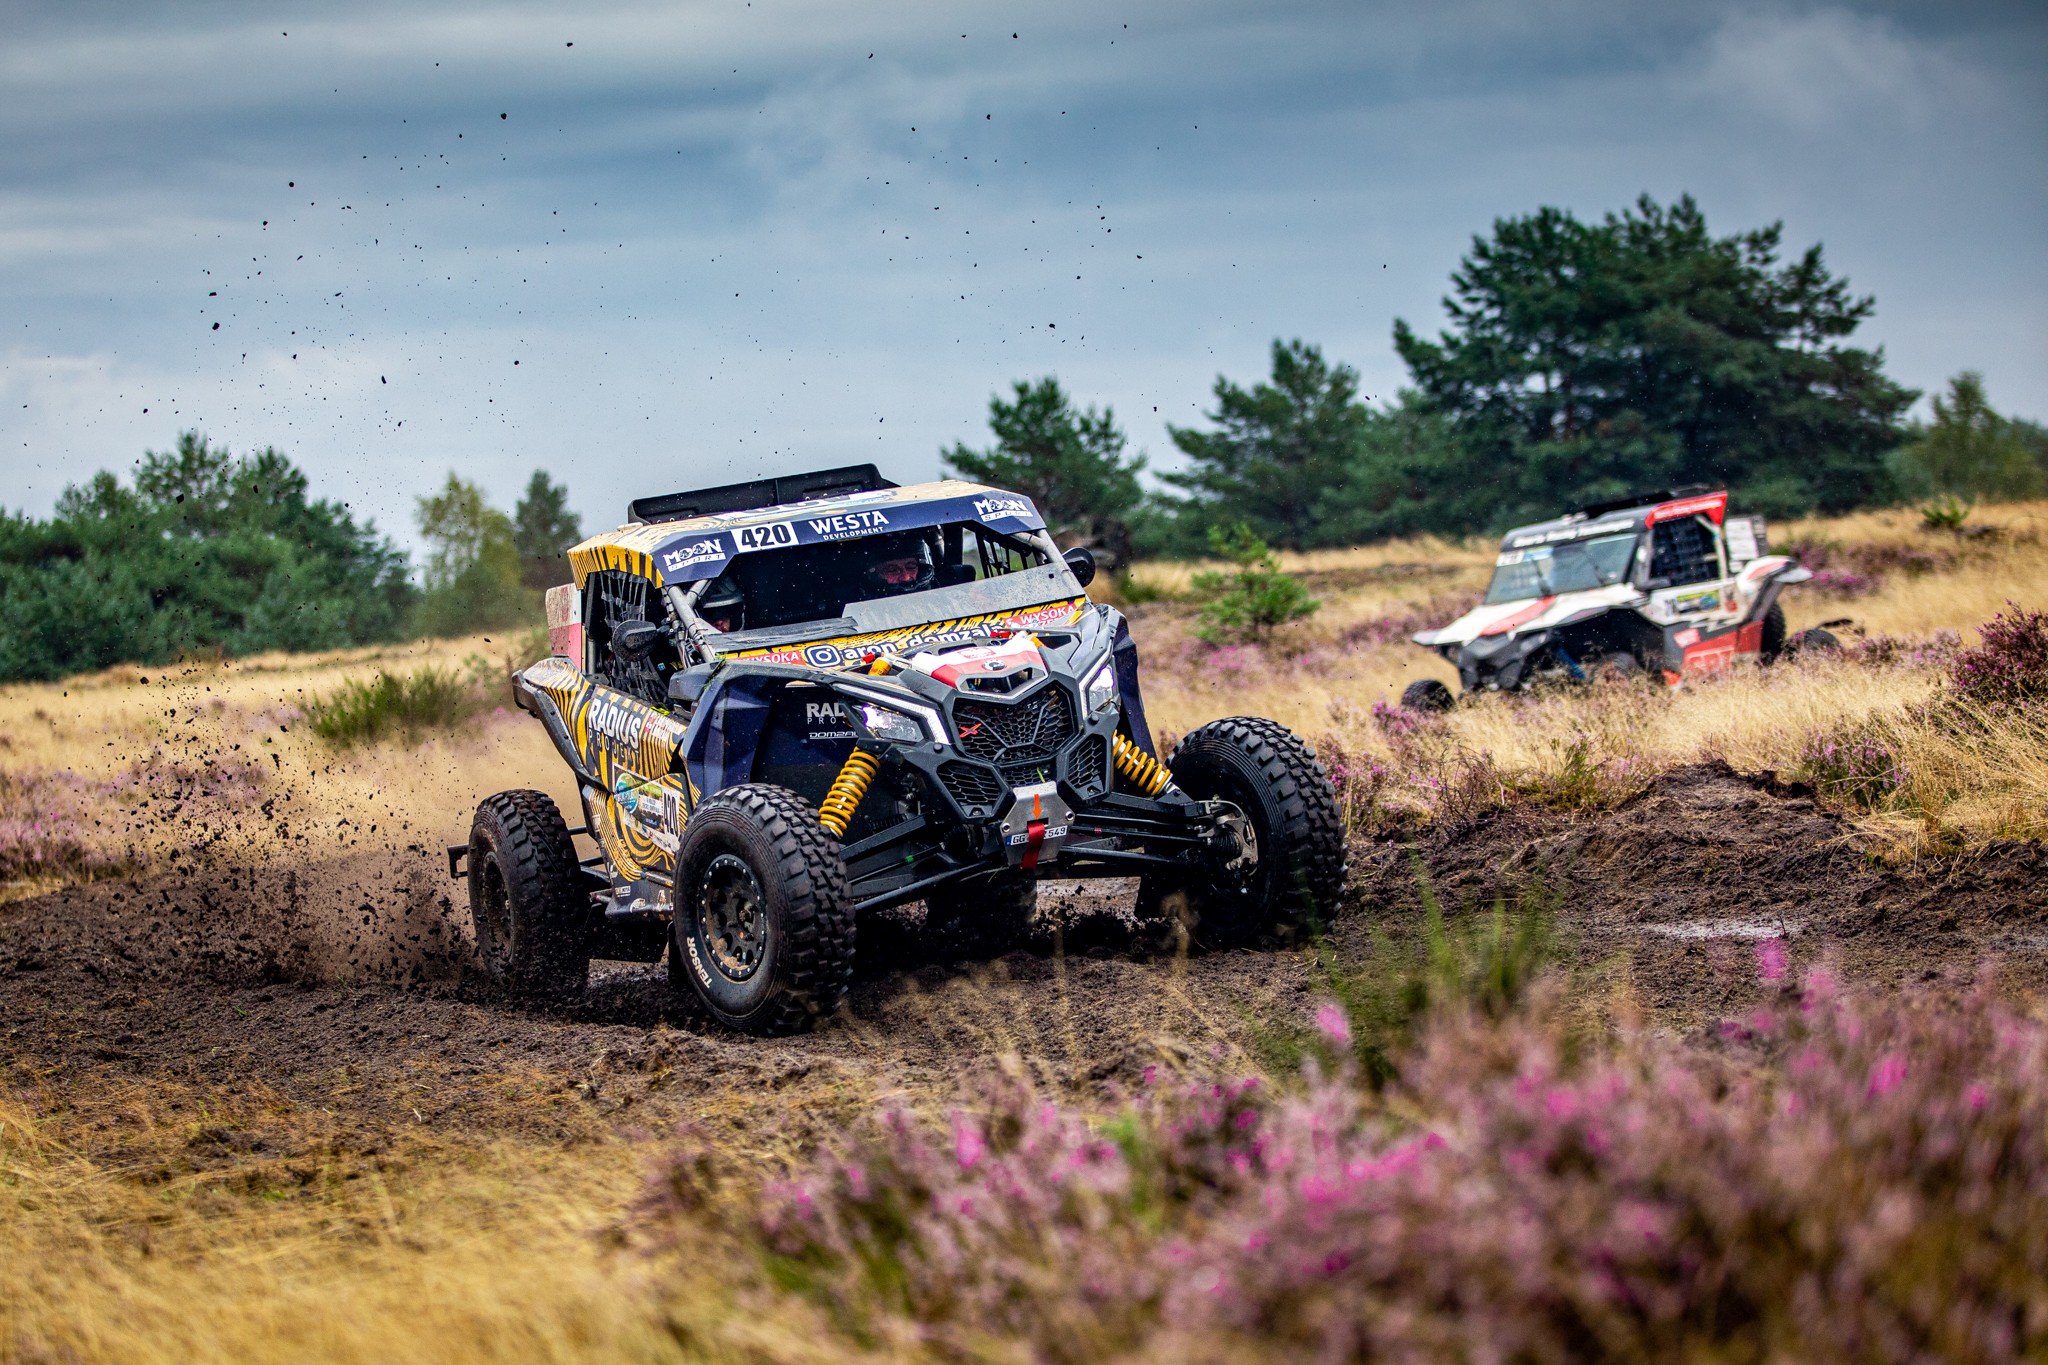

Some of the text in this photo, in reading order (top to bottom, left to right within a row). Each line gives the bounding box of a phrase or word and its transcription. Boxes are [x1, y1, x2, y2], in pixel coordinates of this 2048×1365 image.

[972, 498, 1028, 515] MOON
[808, 510, 889, 534] WESTA
[741, 524, 792, 549] 420
[823, 526, 883, 541] DEVELOPMENT
[663, 538, 724, 566] MOON
[670, 554, 724, 571] SPORT
[1020, 605, 1075, 625] WYSOKA
[588, 698, 641, 749] RADIUS
[1043, 827, 1066, 839] 549
[686, 936, 713, 989] TENSOR
